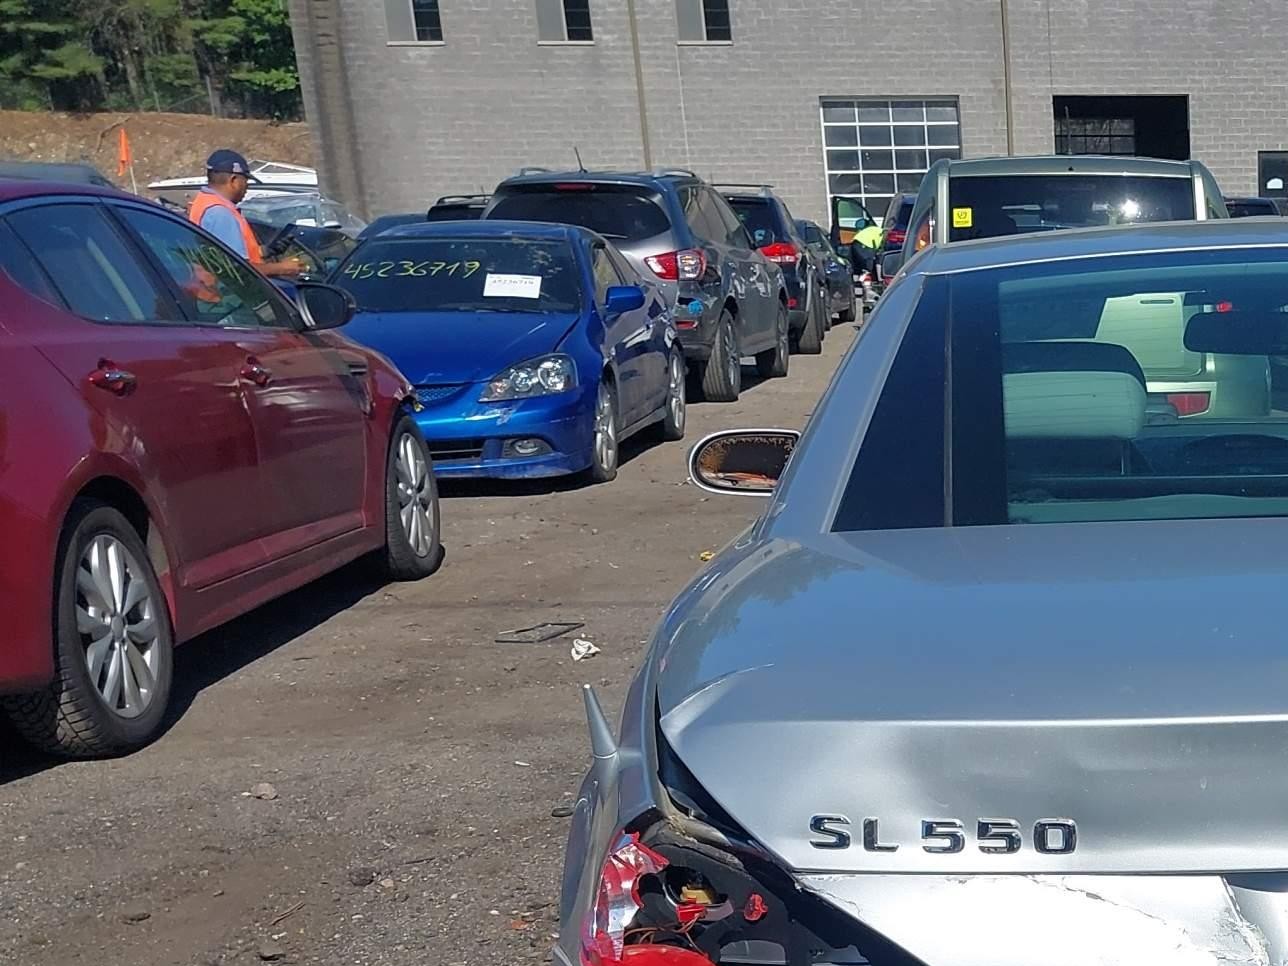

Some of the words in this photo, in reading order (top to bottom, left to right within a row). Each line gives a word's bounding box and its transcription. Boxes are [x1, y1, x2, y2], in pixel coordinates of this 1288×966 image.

[344, 261, 480, 279] 45236719
[808, 813, 900, 853] SL
[920, 817, 1080, 855] 550
